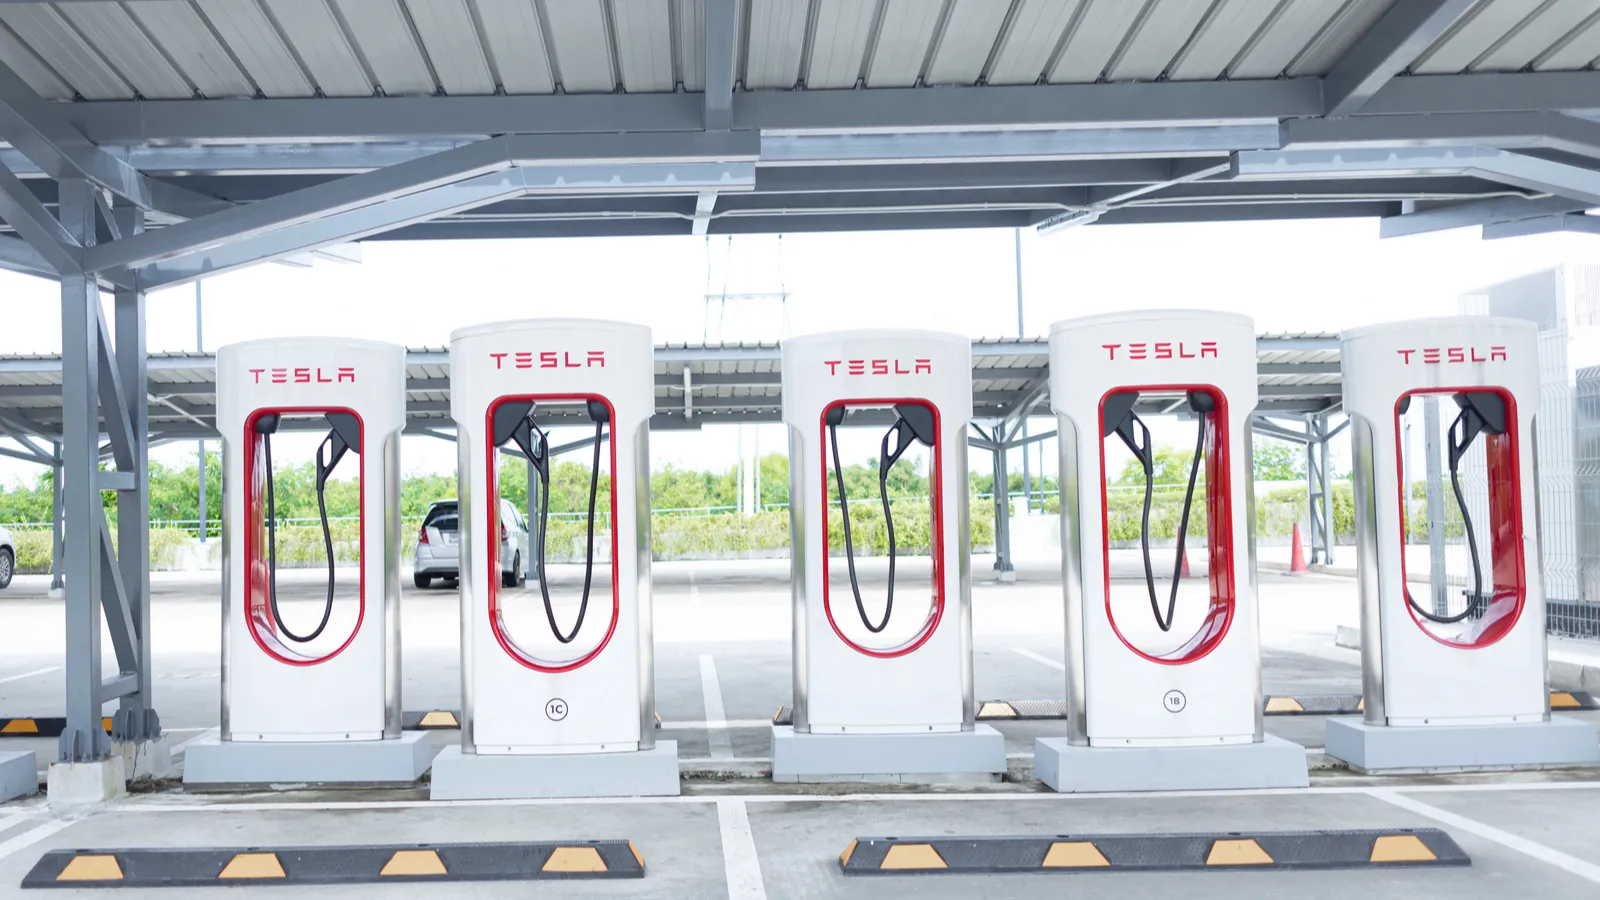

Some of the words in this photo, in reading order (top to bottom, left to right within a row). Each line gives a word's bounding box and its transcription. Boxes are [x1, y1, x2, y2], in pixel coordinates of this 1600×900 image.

[490, 351, 605, 369] TESLA
[1102, 342, 1217, 361] TESLA
[1397, 346, 1507, 364] TESLA
[249, 367, 355, 384] TESLA
[824, 359, 931, 376] TESLA
[550, 704, 563, 714] 1C
[1169, 697, 1180, 705] 1B
